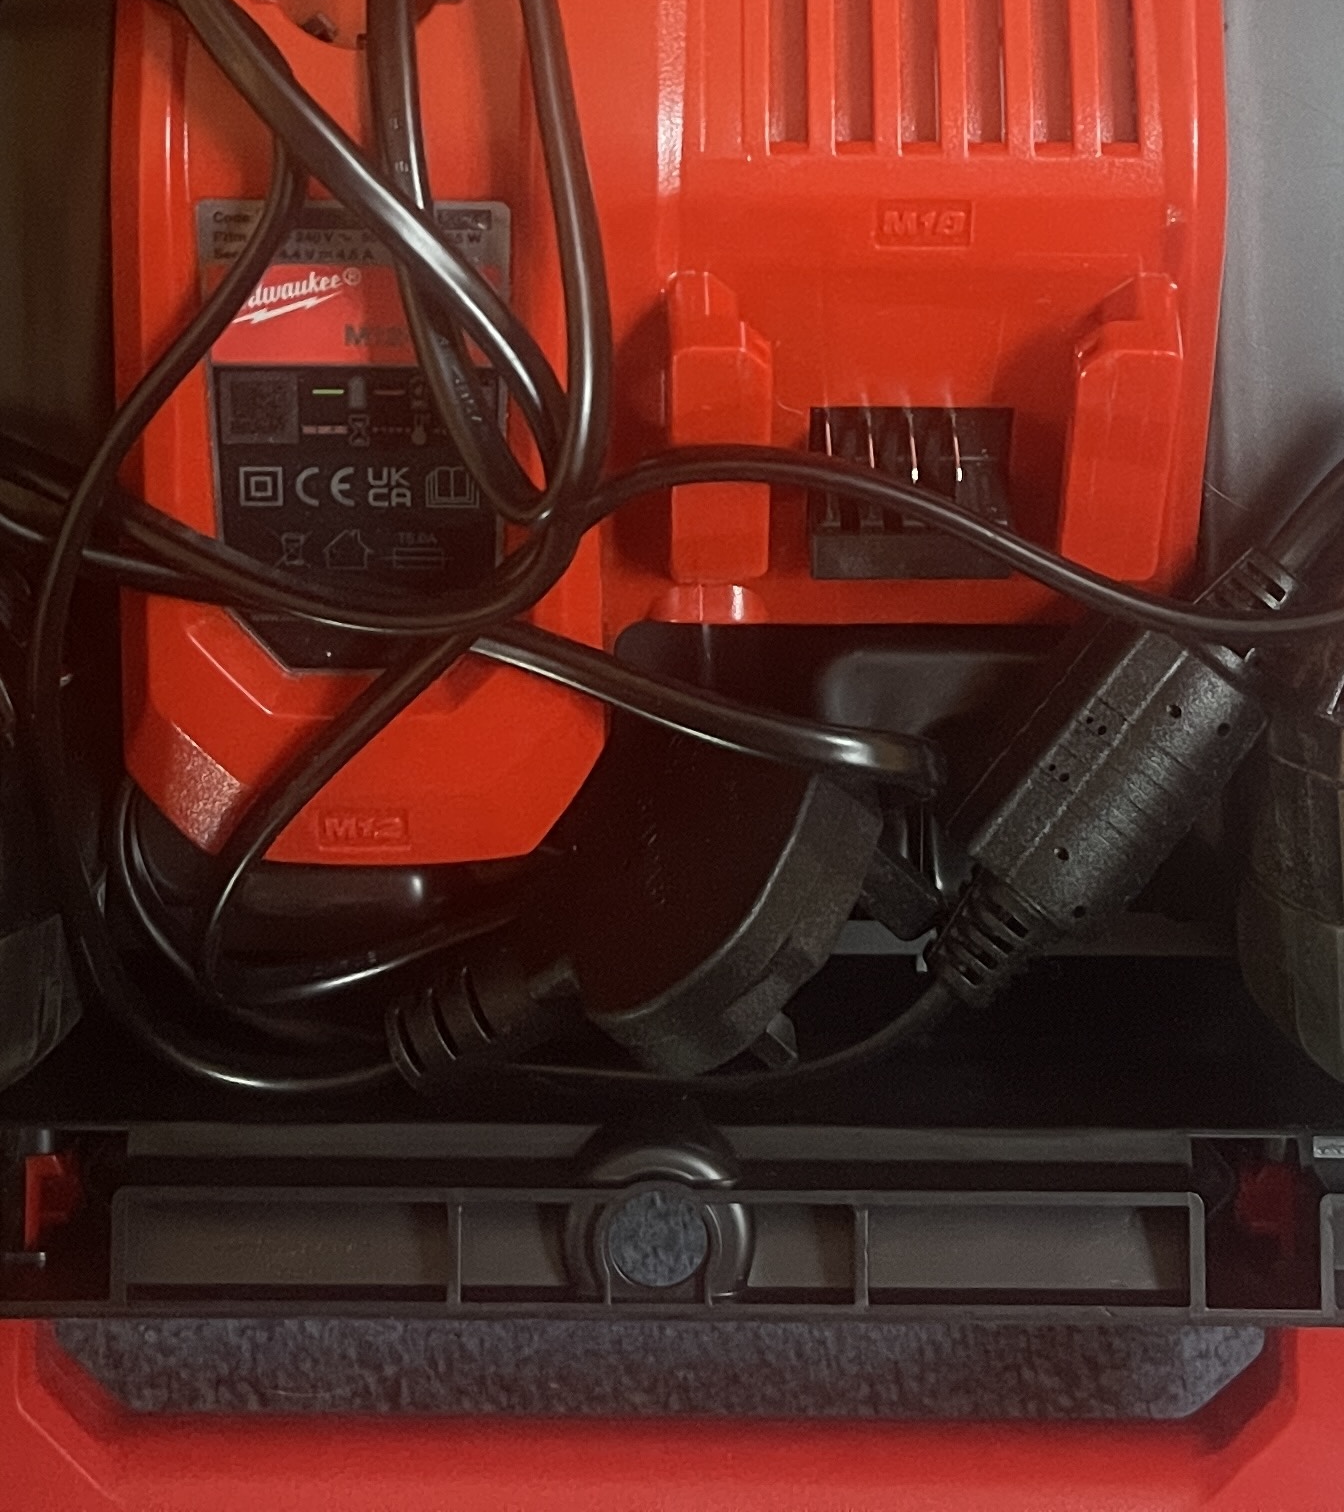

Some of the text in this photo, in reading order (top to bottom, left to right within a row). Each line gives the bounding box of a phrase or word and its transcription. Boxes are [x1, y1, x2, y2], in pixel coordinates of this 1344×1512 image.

[295, 466, 355, 507] CE
[367, 467, 411, 487] UK
[367, 488, 412, 507] CA
